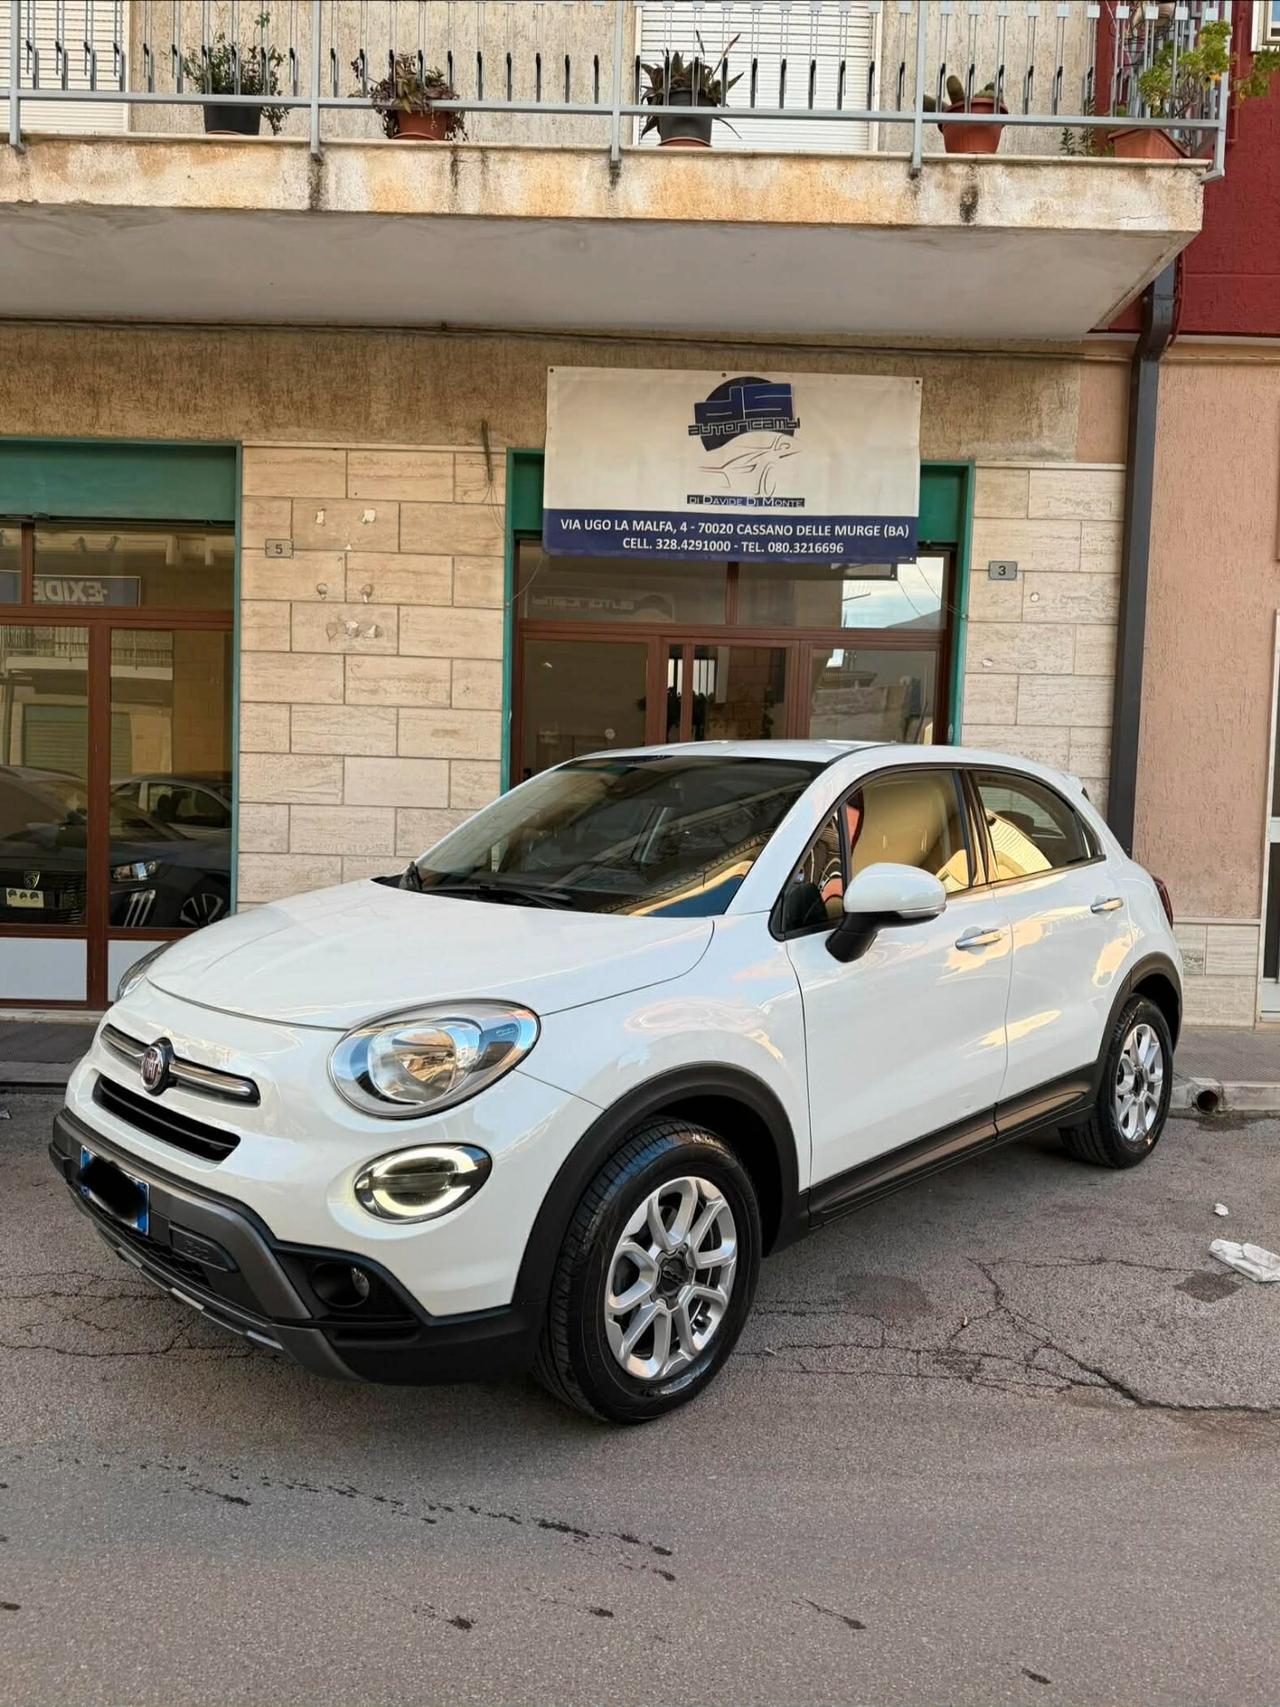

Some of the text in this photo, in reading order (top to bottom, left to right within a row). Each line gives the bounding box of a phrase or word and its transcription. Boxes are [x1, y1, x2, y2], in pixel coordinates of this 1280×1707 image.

[689, 496, 700, 504] DI
[704, 495, 743, 505] DAVIDE
[763, 497, 803, 508] MONTE
[560, 518, 581, 530] VIA
[584, 519, 611, 531] UGO
[615, 520, 629, 531] LA
[632, 520, 676, 534] MALFA,
[680, 521, 687, 532] 4
[698, 522, 733, 535] 70020
[736, 523, 793, 536] CASSANO
[796, 524, 831, 536] DELLE
[834, 525, 880, 537] MURGE
[883, 524, 909, 539] (BA)
[274, 543, 283, 555] 5
[622, 537, 652, 549] CELL.
[655, 538, 731, 552] 328.4291000
[741, 541, 765, 553] TEL.
[767, 541, 844, 554] 080.3216696
[998, 565, 1007, 576] 3
